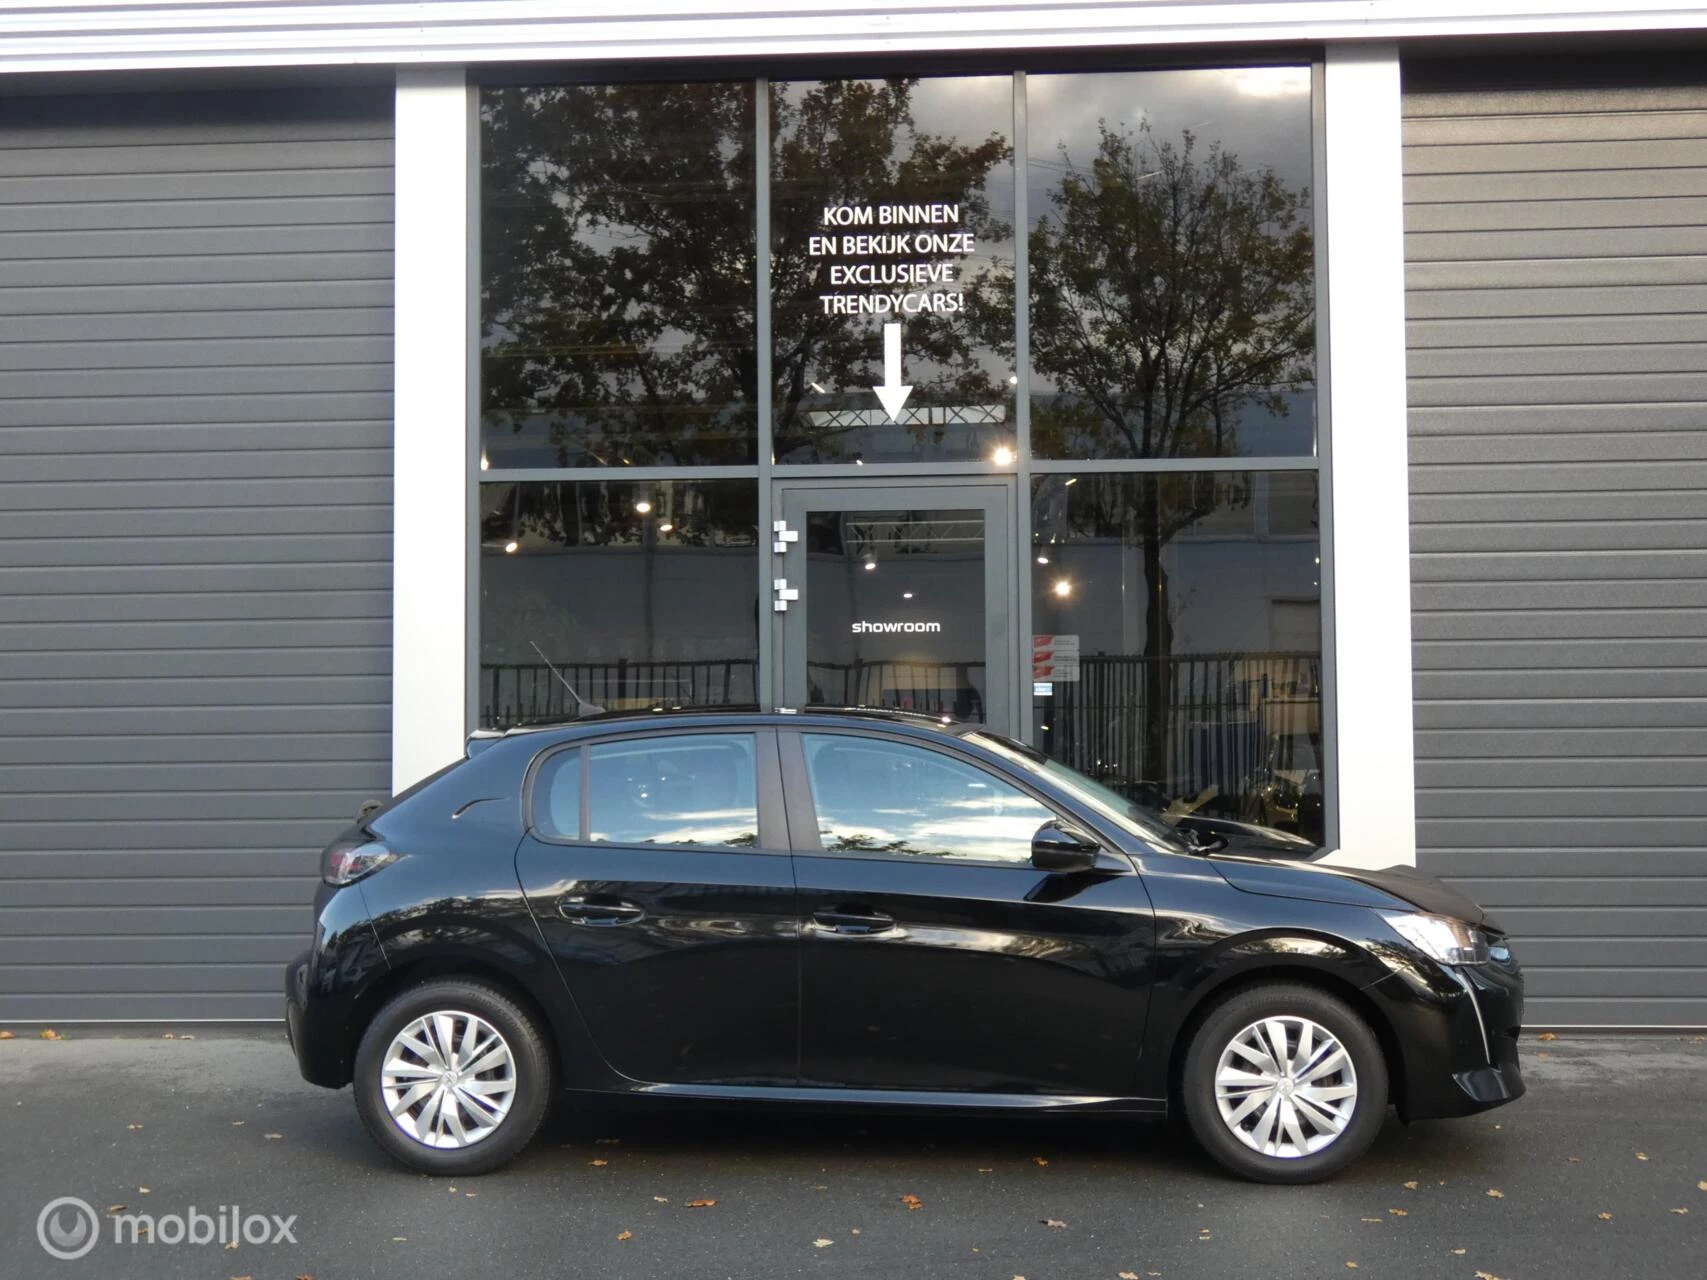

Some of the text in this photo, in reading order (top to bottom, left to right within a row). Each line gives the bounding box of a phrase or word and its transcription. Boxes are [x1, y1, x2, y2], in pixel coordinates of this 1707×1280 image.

[823, 204, 959, 226] KOM BINNEN
[809, 233, 975, 256] EN BEKIJK ONZE
[830, 263, 954, 285] EXCLUSIEVE
[819, 293, 964, 314] TRENDYCARS!
[851, 620, 941, 633] showroom
